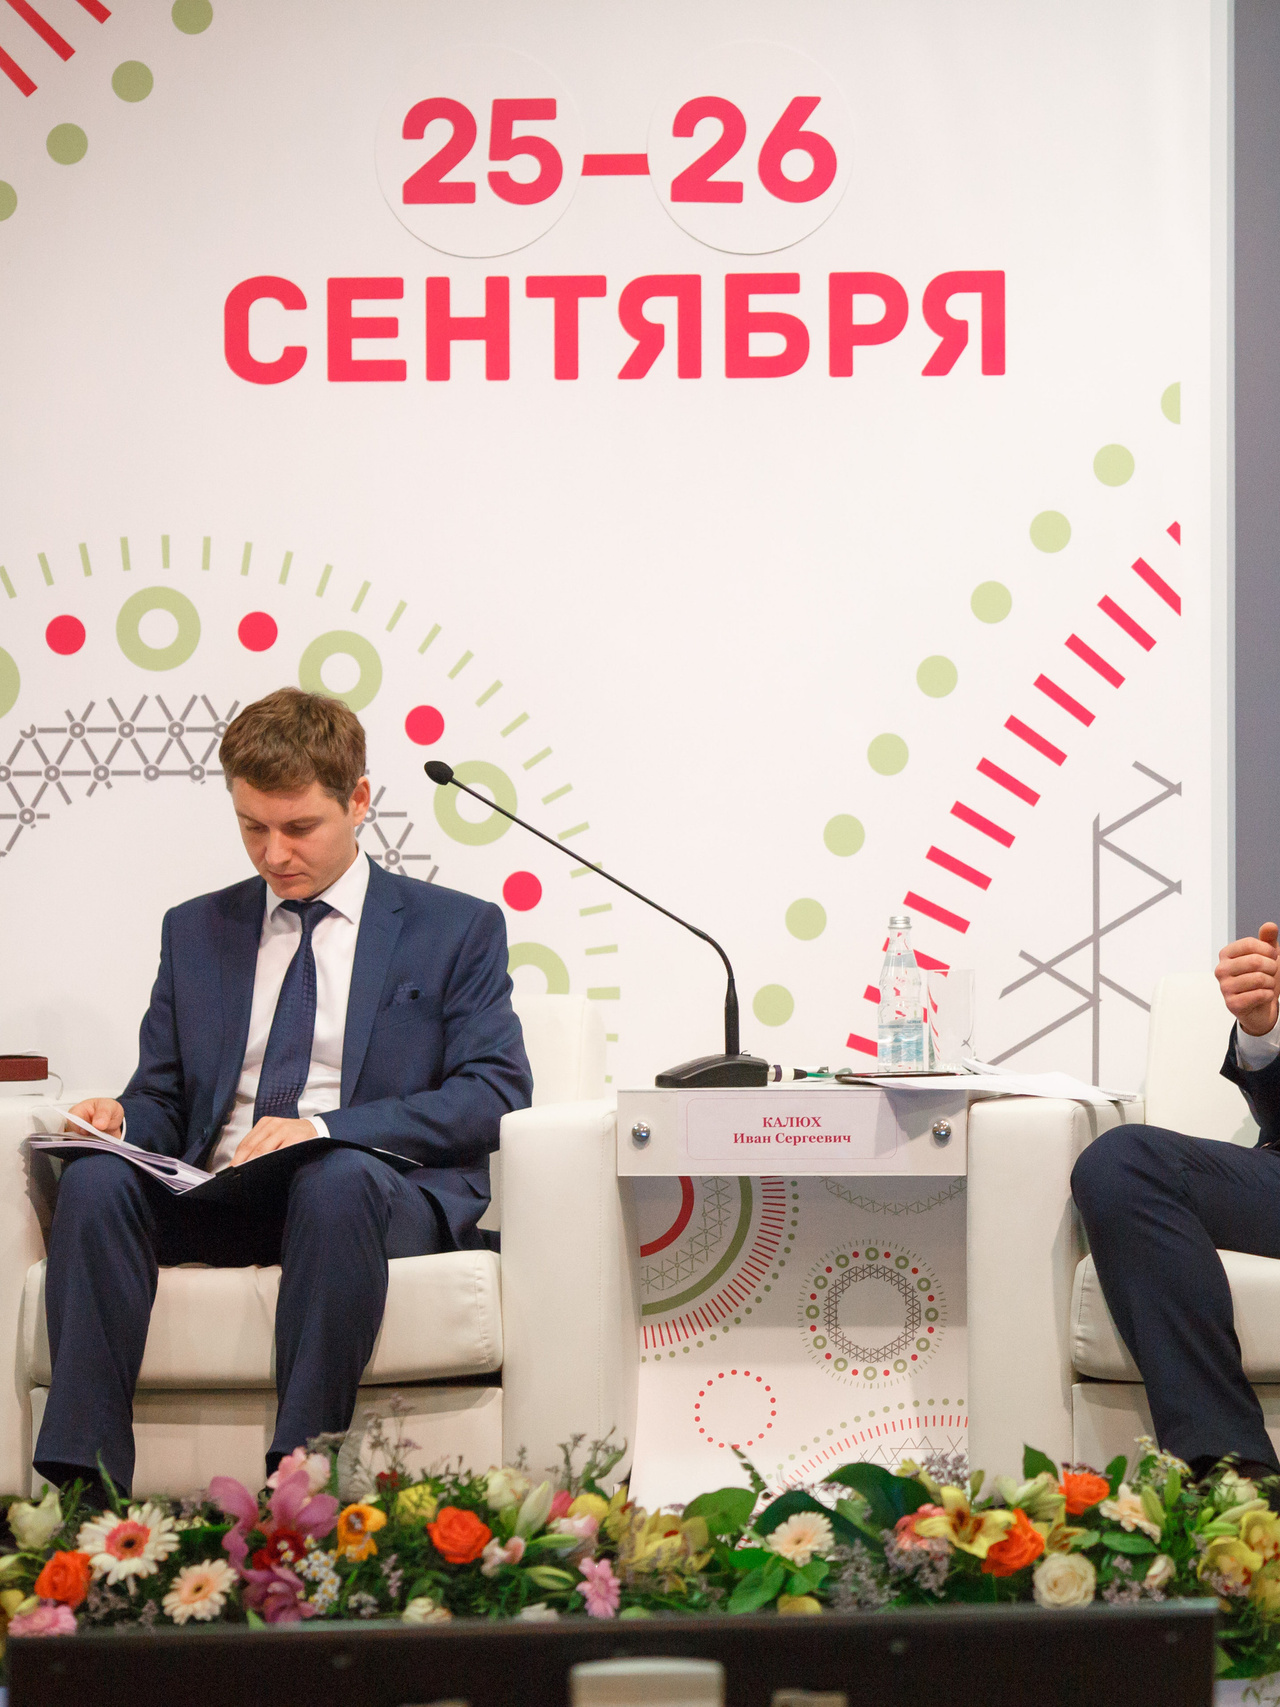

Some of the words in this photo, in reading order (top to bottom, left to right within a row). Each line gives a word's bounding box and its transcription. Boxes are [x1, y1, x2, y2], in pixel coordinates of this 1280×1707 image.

[223, 270, 1006, 386] СЕНТЯБРЯ
[762, 1116, 822, 1128] КАЛЮХ
[733, 1133, 771, 1144] Иван
[775, 1132, 851, 1146] Сергеевич
